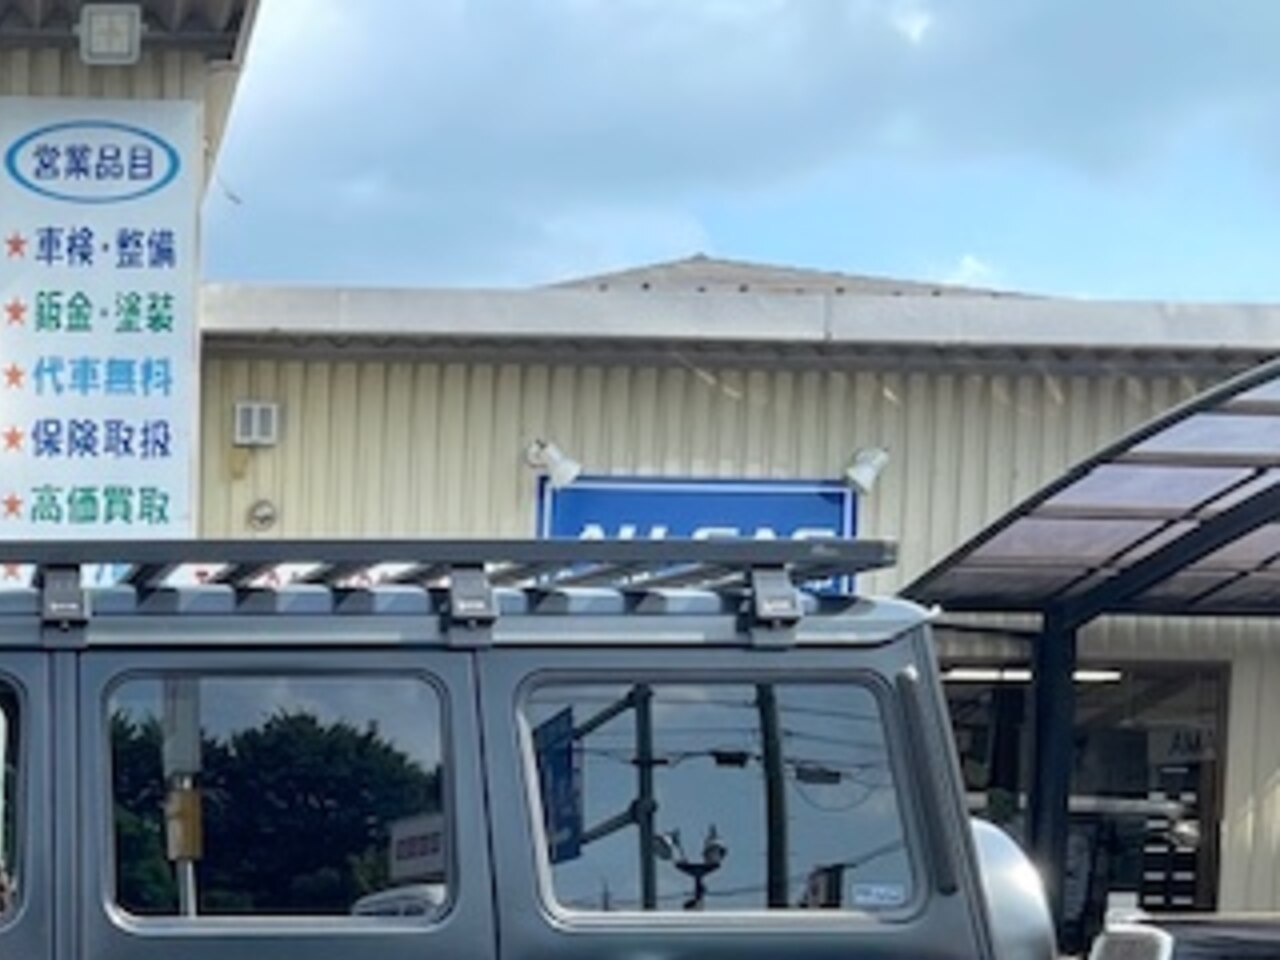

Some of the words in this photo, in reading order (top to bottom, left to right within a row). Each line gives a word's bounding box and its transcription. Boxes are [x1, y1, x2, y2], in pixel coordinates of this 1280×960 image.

[32, 145, 155, 181] 営業品目
[35, 226, 176, 268] 車検・整備
[32, 357, 173, 397] 代車無料
[31, 418, 172, 459] 保険取扱
[30, 484, 170, 525] 高価買取
